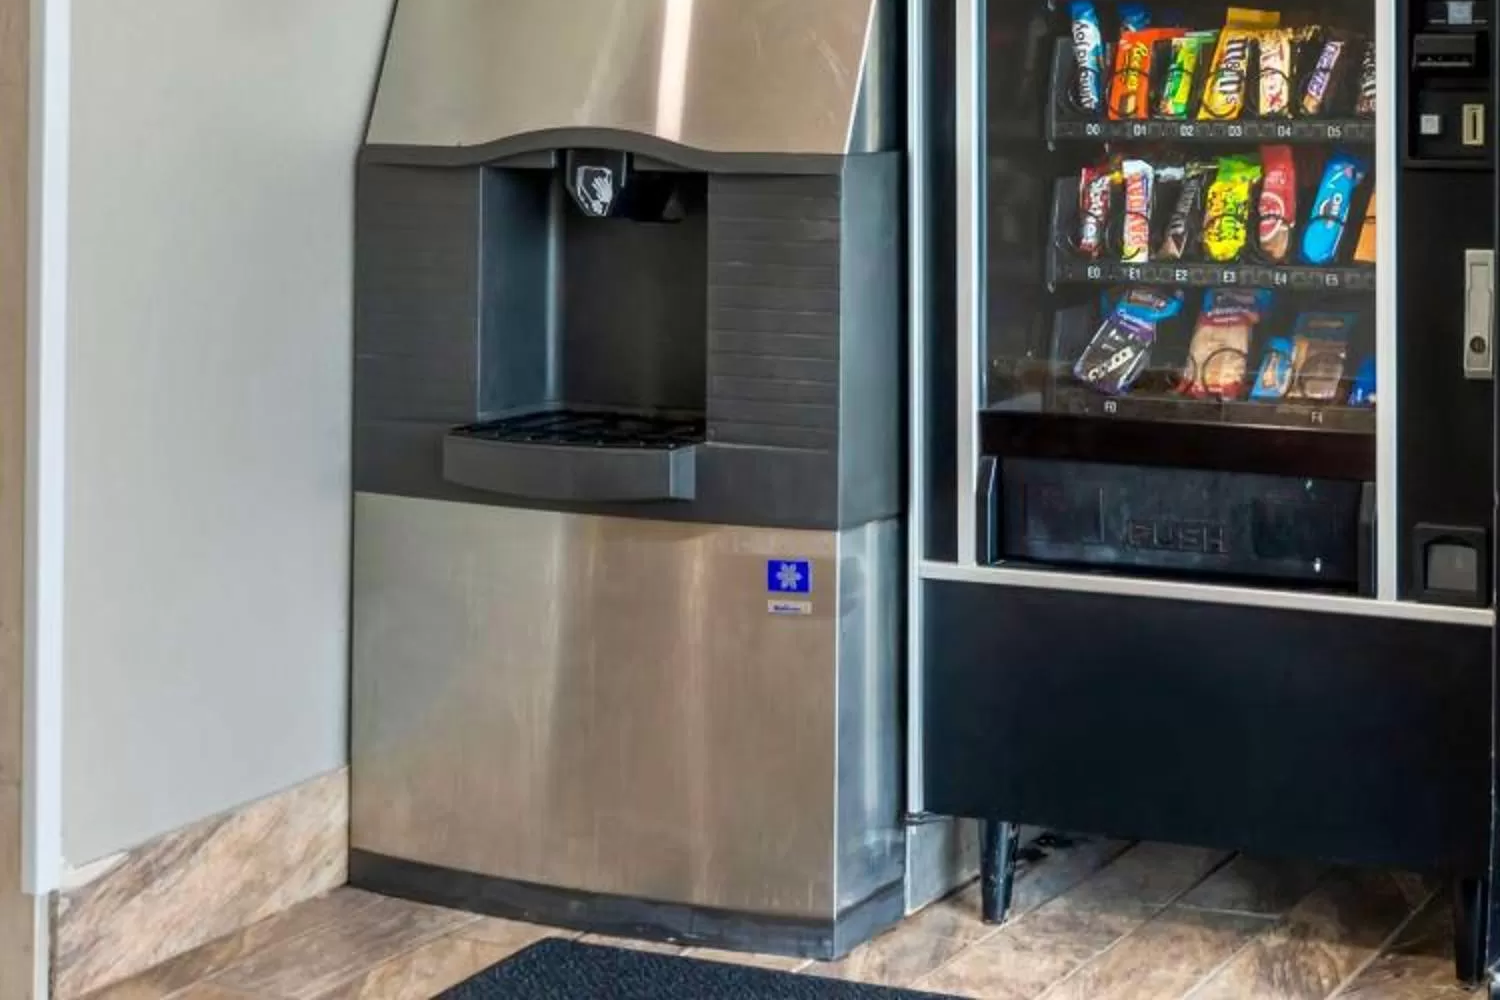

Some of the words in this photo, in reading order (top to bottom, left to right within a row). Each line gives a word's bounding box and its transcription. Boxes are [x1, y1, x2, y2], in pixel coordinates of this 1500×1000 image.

[1071, 20, 1090, 48] Joy
[1075, 49, 1097, 110] Almond
[1180, 124, 1194, 137] D2
[1228, 124, 1242, 137] D3
[1277, 125, 1291, 137] D4
[1327, 126, 1341, 138] D5
[1129, 267, 1142, 280] E1
[1175, 269, 1188, 281] E2
[1223, 270, 1236, 283] E3
[1128, 519, 1227, 553] PUSH
